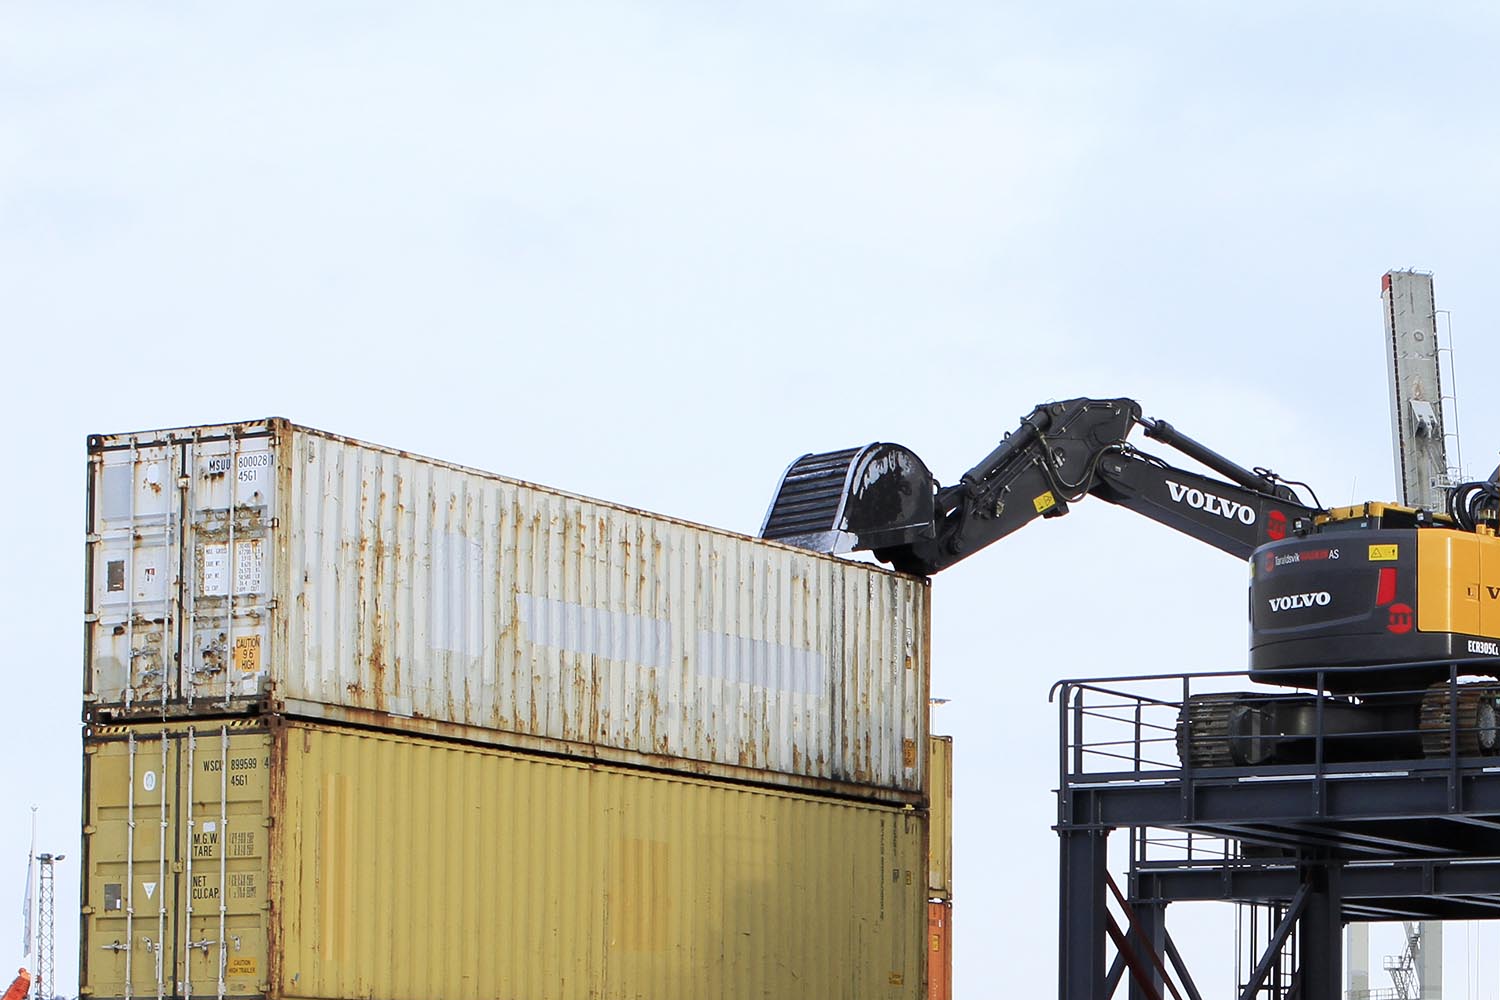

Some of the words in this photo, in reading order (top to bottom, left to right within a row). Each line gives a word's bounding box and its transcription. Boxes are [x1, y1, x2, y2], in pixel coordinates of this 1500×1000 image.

[209, 458, 231, 471] MSUU
[238, 455, 269, 468] 800028
[238, 470, 257, 481] 45G1
[1165, 480, 1256, 525] VOLVO
[1328, 549, 1340, 559] AS
[1269, 591, 1331, 612] VOLVO
[231, 775, 248, 786] 45G1
[193, 846, 213, 856] TARE
[193, 876, 207, 887] NET
